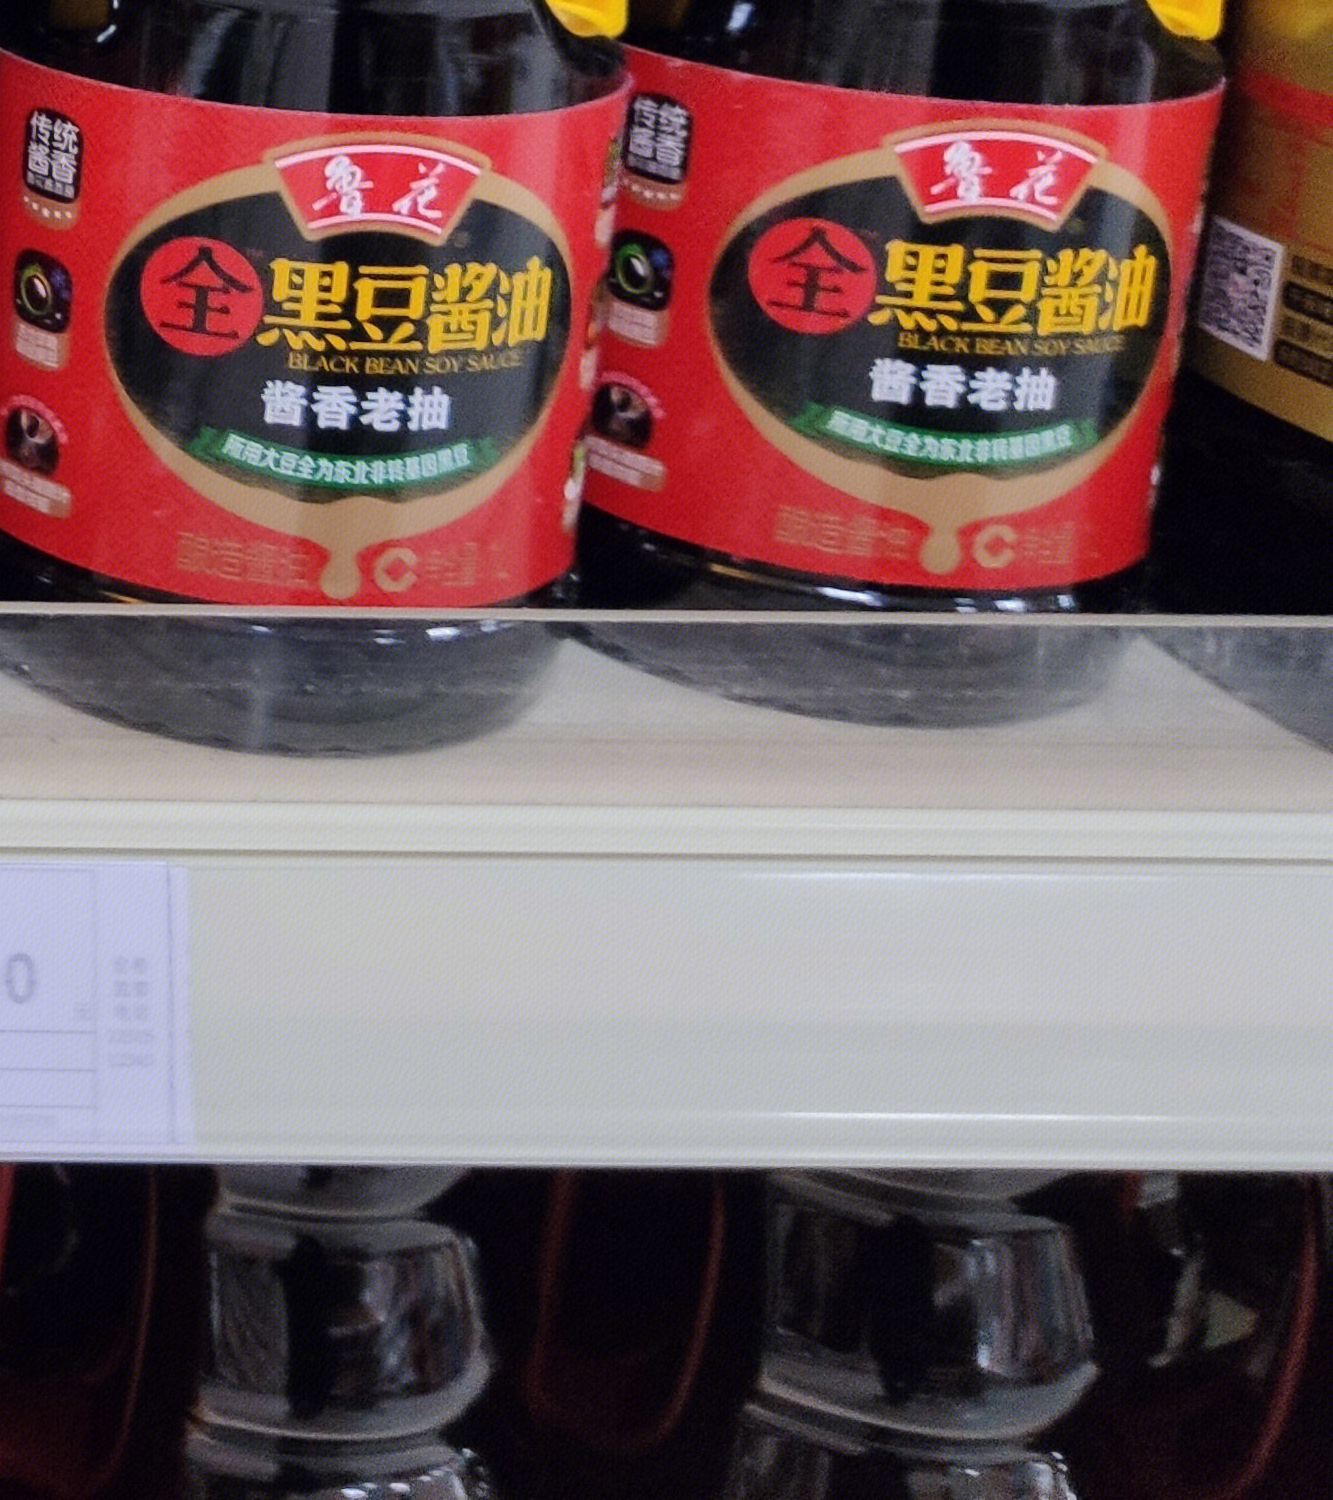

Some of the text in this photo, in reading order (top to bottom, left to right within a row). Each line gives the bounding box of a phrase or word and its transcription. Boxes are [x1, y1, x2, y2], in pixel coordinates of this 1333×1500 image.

[29, 109, 80, 155] 传统
[312, 153, 443, 219] 鲁花
[930, 139, 1063, 206] 鲁花
[159, 245, 553, 355] 全 黑豆酱油
[770, 225, 1159, 338] 全 黑豆酱油
[287, 351, 360, 375] BLACK
[363, 354, 419, 376] BEAN
[422, 353, 465, 375] SOY
[897, 331, 971, 355] BLACK
[260, 379, 454, 436] 酱香老抽
[868, 356, 1059, 414] 酱香老抽
